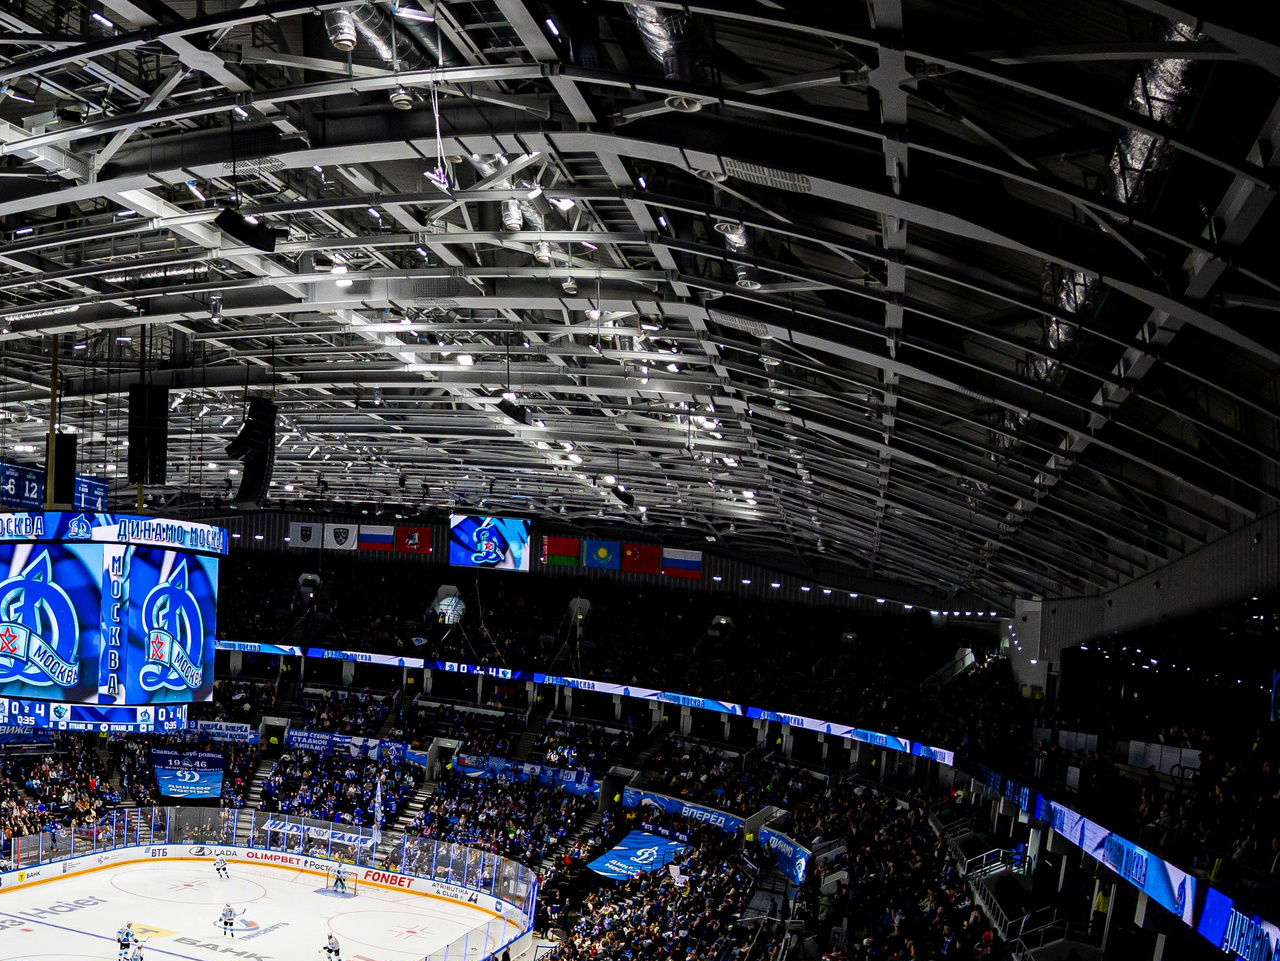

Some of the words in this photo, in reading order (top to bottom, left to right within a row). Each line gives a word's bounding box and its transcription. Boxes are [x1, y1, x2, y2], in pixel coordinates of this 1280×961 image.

[25, 481, 38, 498] 12
[117, 519, 184, 544] ДИНАМО
[108, 555, 122, 695] МОСКВА
[33, 645, 78, 684] МОСКВА
[174, 651, 204, 687] МОСКВА
[460, 665, 467, 673] 0
[489, 668, 496, 676] 4
[11, 702, 19, 714] 0
[35, 704, 45, 717] 4
[158, 708, 166, 721] 0
[176, 708, 182, 718] 4
[292, 737, 327, 745] СТАДИОН
[682, 806, 726, 828] ВПЕРЁД
[151, 848, 168, 857] ВТБ
[214, 849, 238, 857] LADA
[246, 852, 302, 865] OLIMPBET
[26, 870, 41, 879] БАНК
[364, 870, 415, 888] FONBET
[432, 882, 469, 895] ATRIBUTIKA
[442, 890, 459, 899] CLUB
[20, 896, 108, 919] Haier
